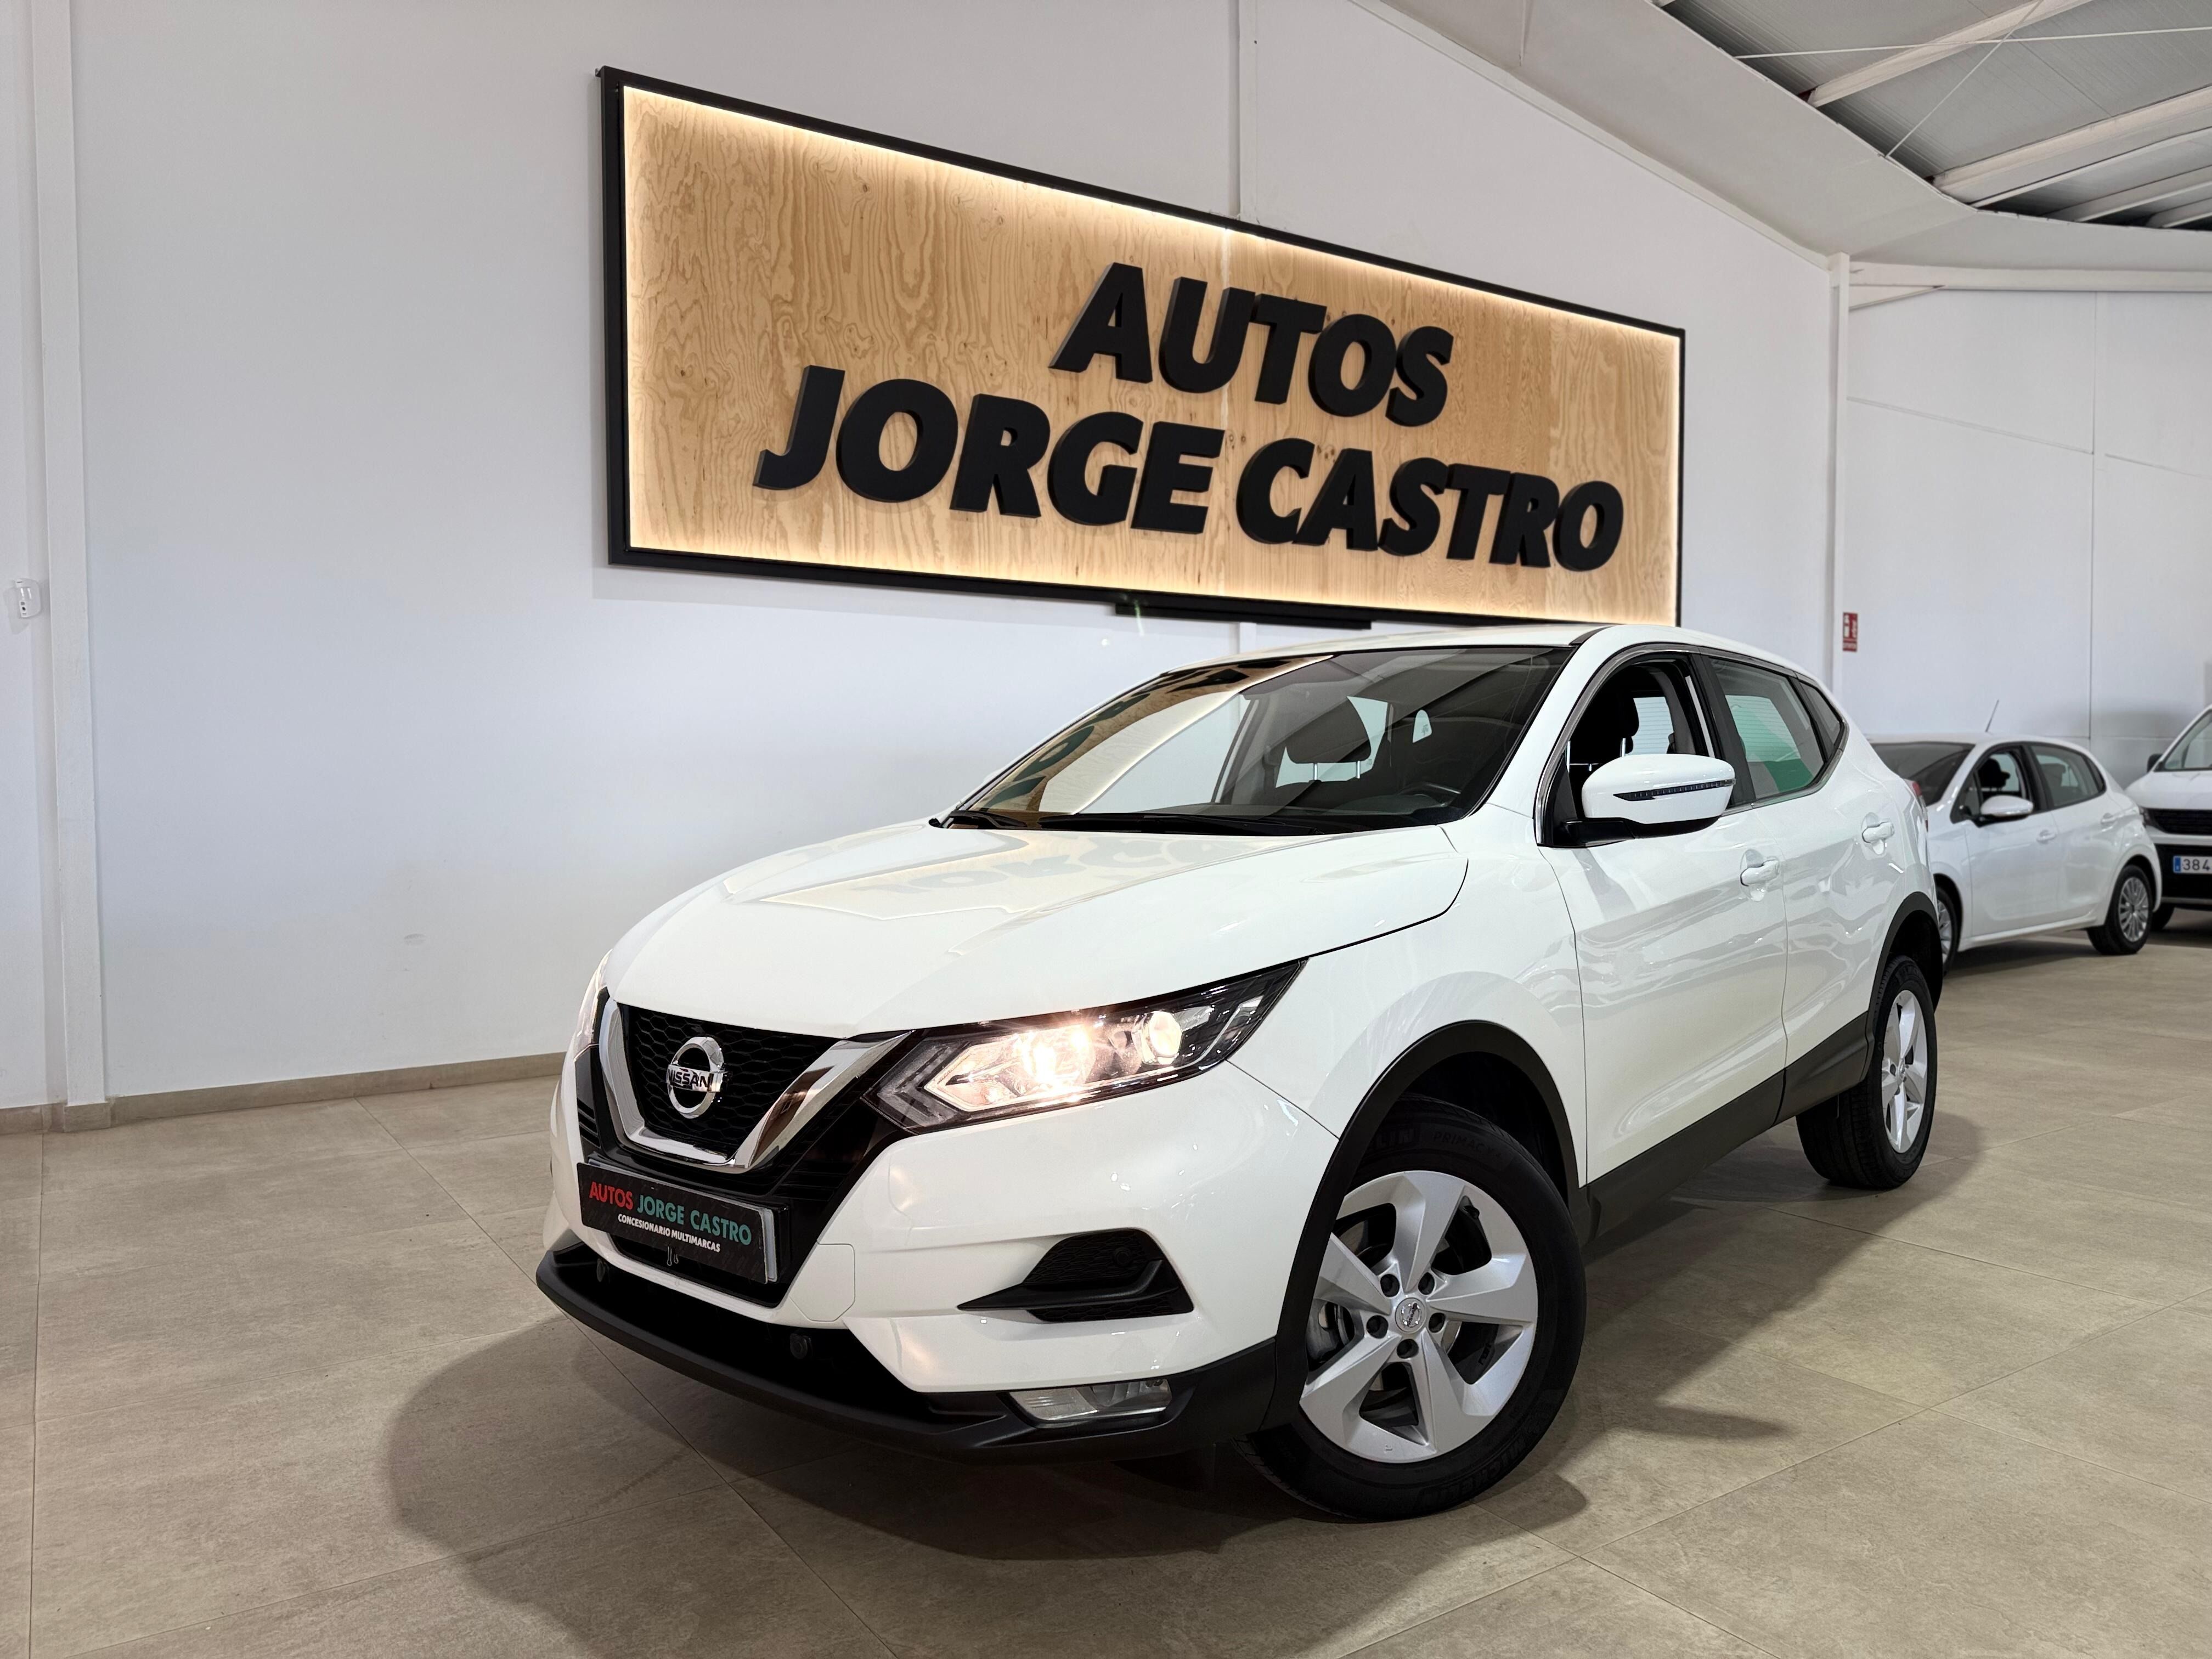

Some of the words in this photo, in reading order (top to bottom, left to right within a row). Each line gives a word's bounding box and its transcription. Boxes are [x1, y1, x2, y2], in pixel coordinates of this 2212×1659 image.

[1048, 262, 1454, 427] AUTOS
[752, 365, 1224, 535] JORGE
[1235, 437, 1624, 572] CASTRO
[668, 1068, 714, 1089] NISSAN
[589, 1181, 633, 1210] AUTOS
[637, 1194, 685, 1225] JORGE
[690, 1210, 752, 1245] CASTRO
[618, 1214, 670, 1237] CONCESIONARIO
[671, 1229, 721, 1253] MULTIMARCAS
